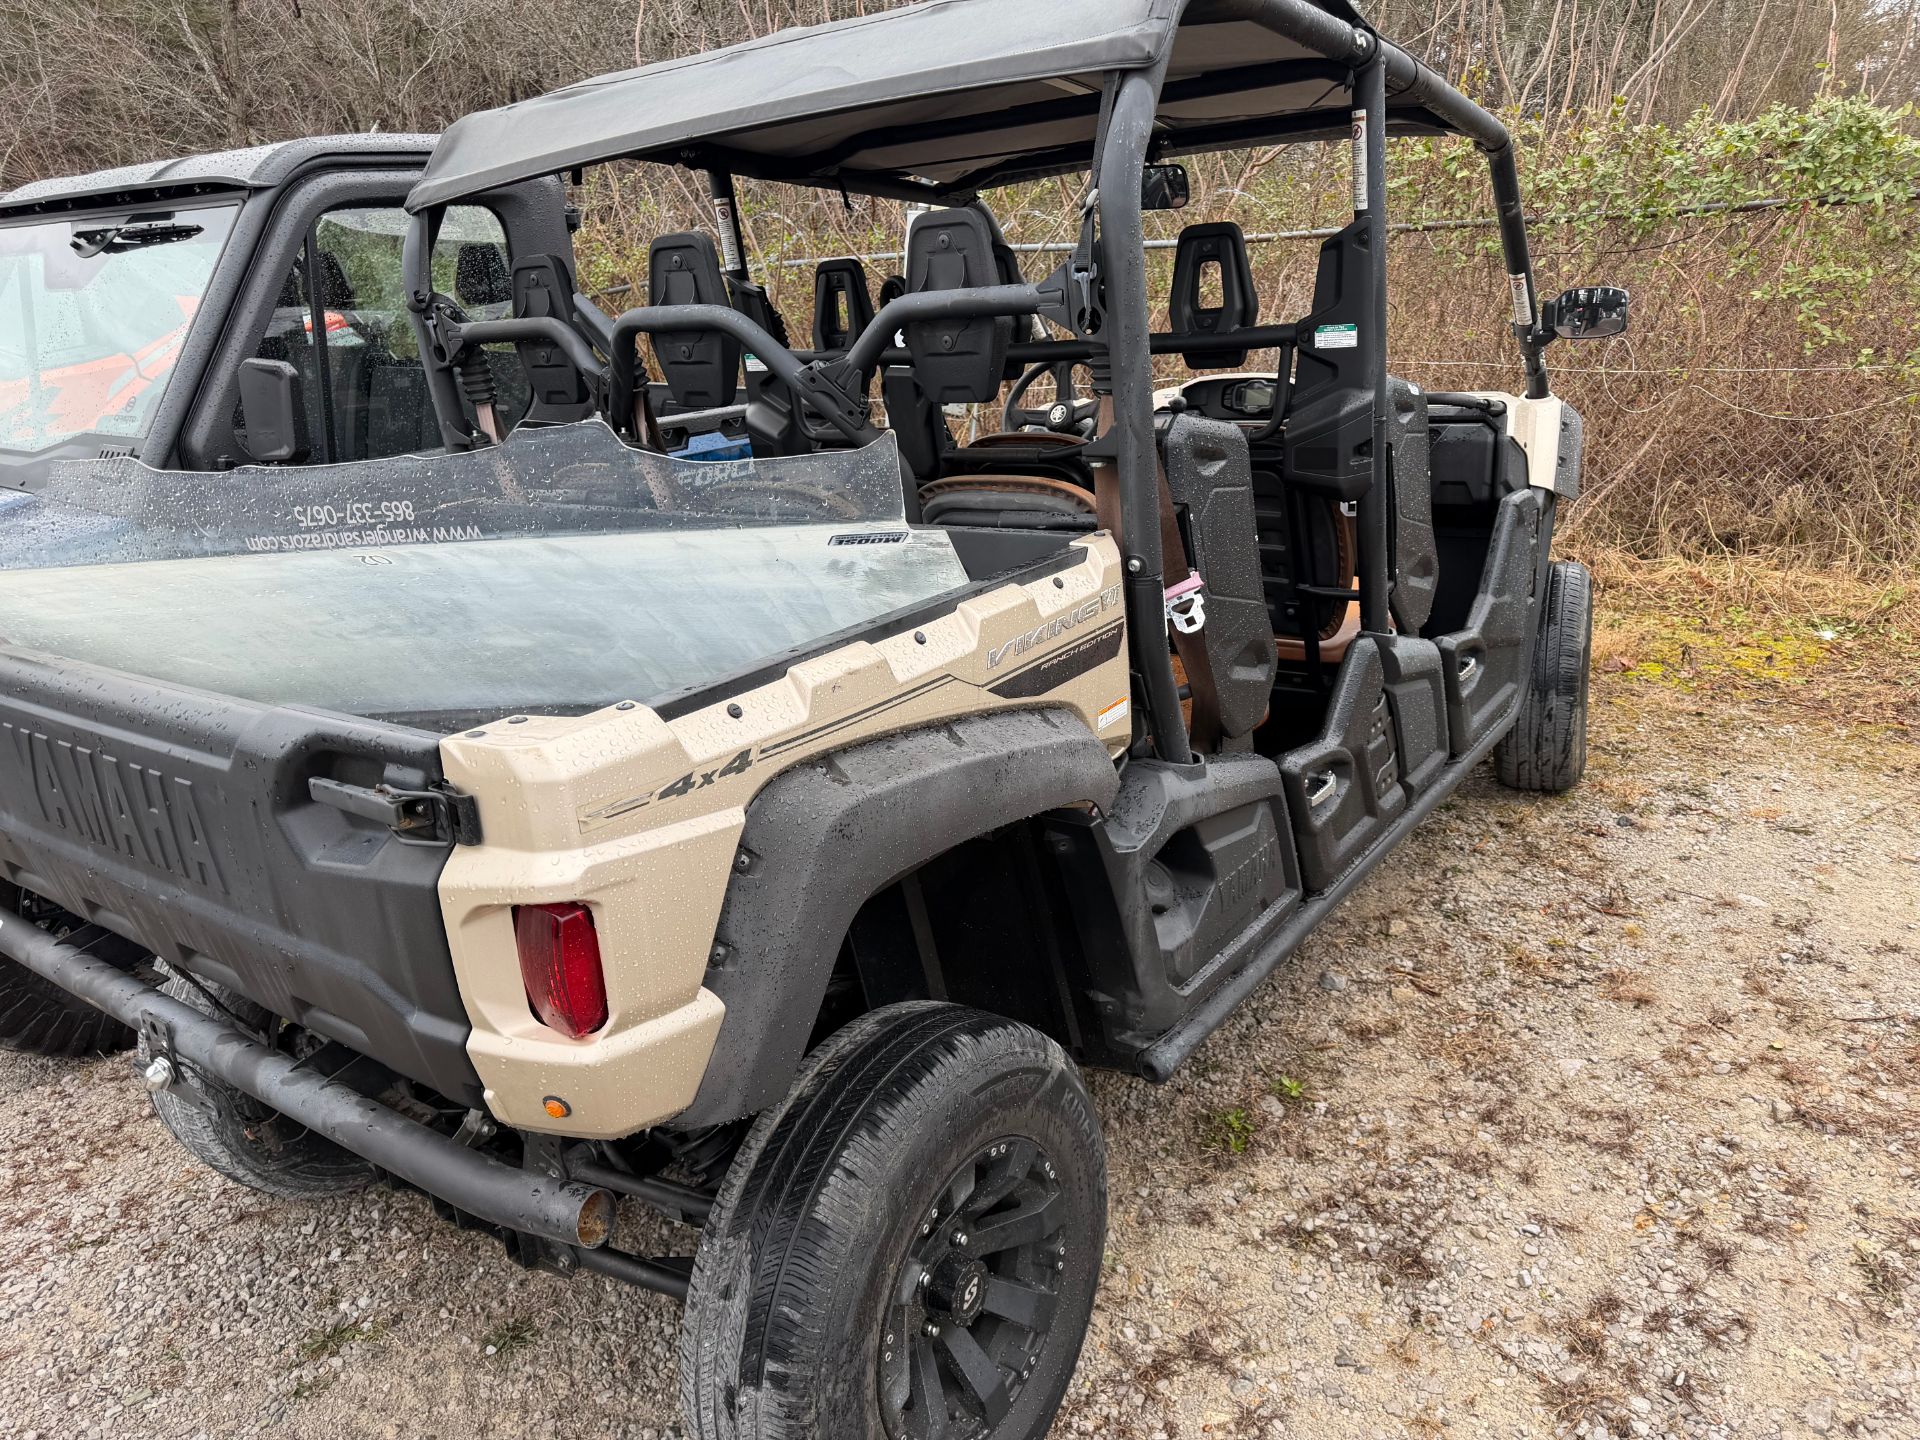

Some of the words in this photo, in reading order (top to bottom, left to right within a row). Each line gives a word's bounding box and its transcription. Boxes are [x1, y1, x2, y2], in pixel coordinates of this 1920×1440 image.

[293, 500, 415, 527] 865-337-0675
[245, 524, 484, 551] www.wranglersandrazors.com
[833, 536, 902, 546] MOOSE
[986, 597, 1100, 670] VIKING
[1040, 647, 1079, 671] RANCH
[1079, 628, 1119, 652] EDITION
[656, 747, 754, 801] 4x4
[3, 721, 231, 896] YAMAHA
